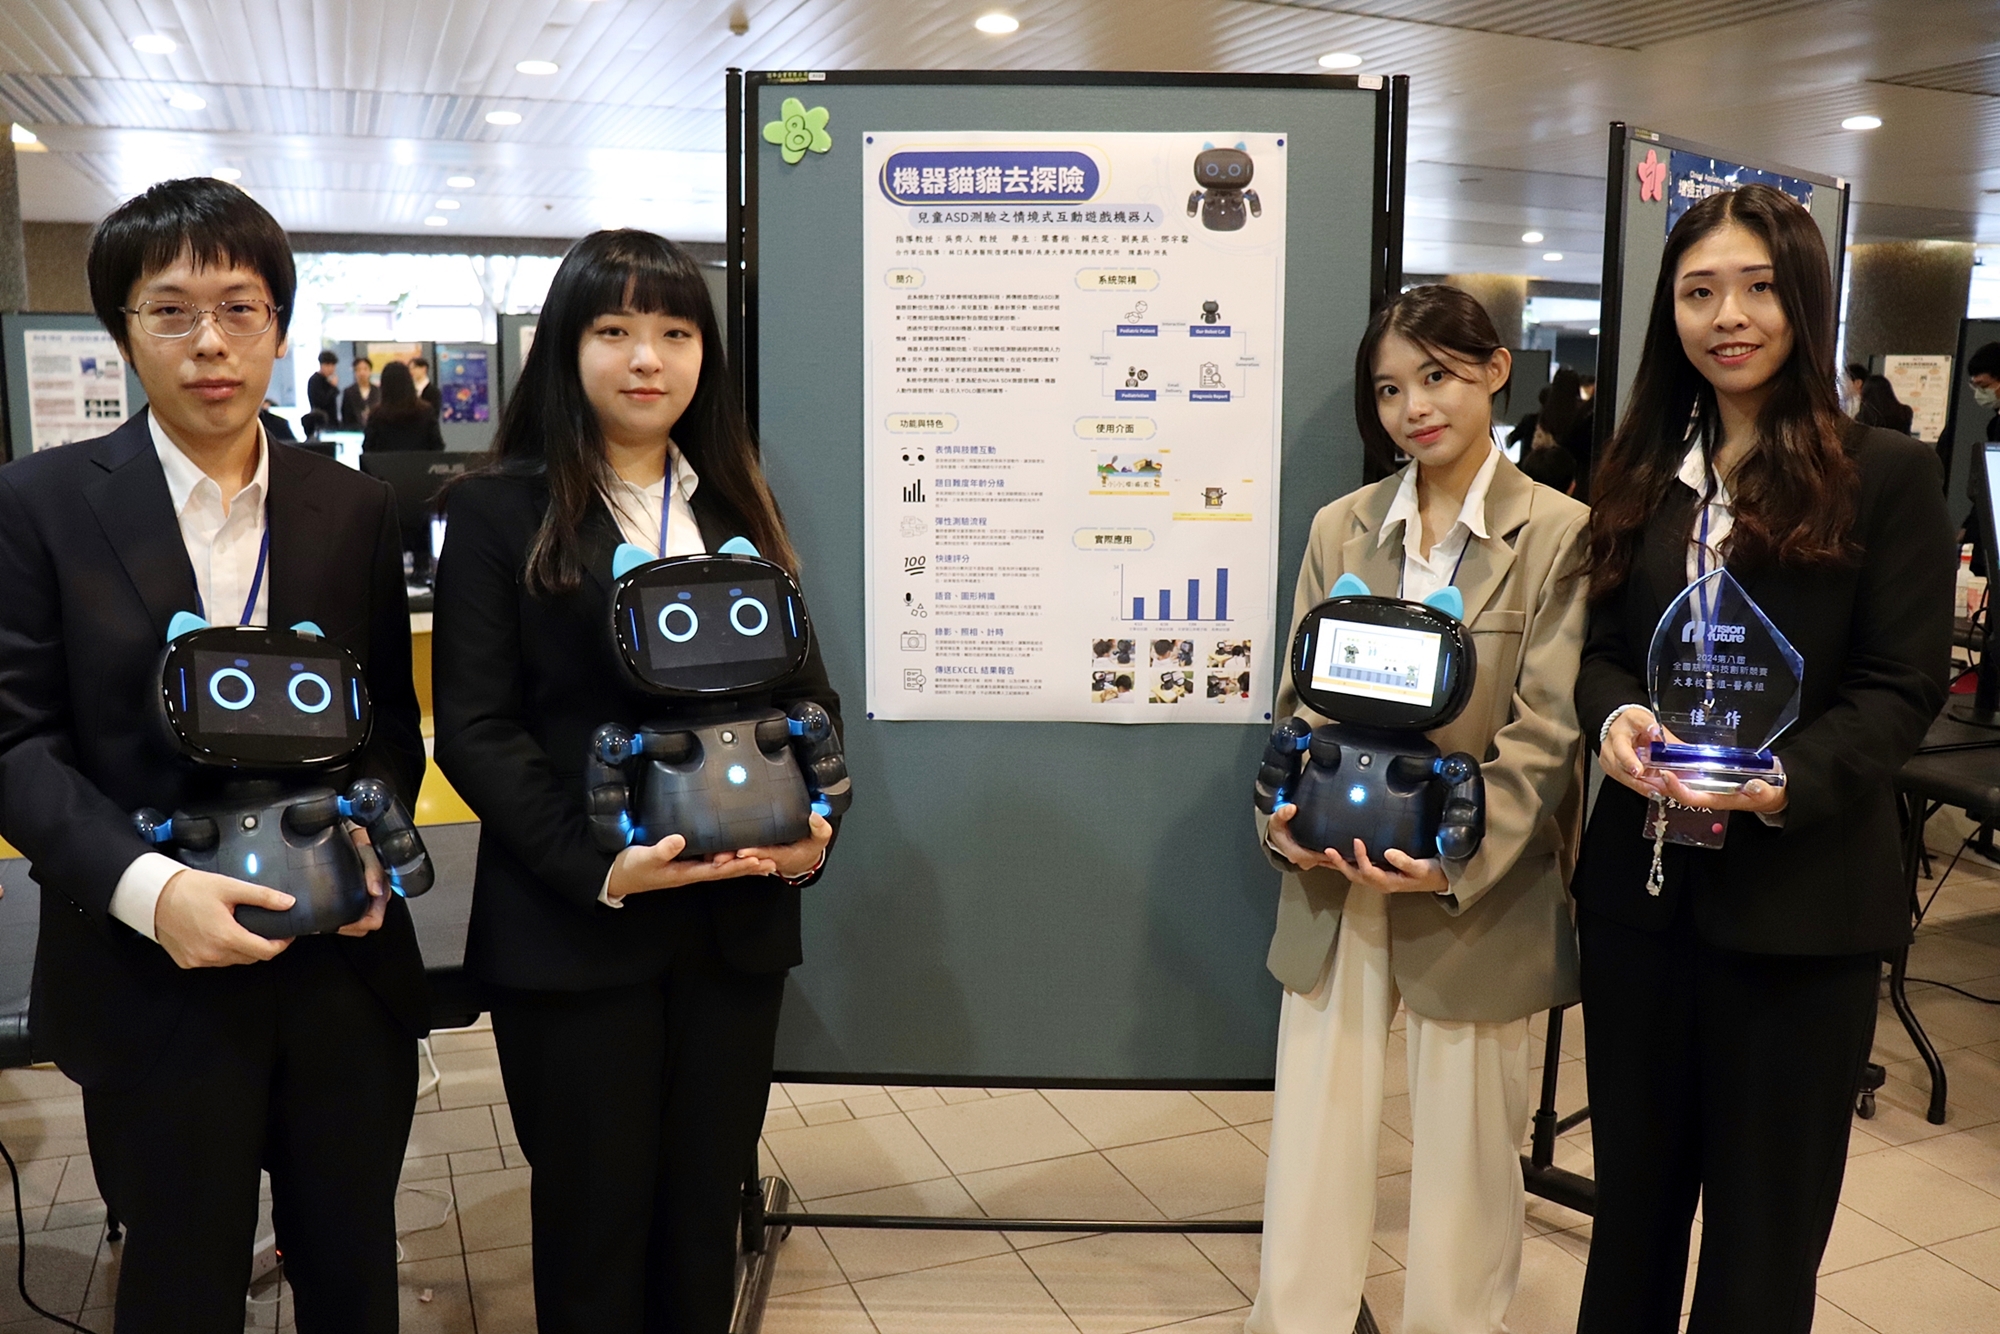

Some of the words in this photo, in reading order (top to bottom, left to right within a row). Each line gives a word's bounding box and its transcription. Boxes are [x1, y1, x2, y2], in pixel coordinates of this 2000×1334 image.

[892, 166, 1085, 195] 機器貓貓去探險
[918, 211, 1154, 223] 兒童ASD測驗之情境式互動遊戲機器人
[979, 235, 997, 243] 教授
[896, 275, 914, 284] 簡介
[1099, 275, 1137, 285] 系統架構
[900, 419, 943, 428] 功能與特色
[1096, 424, 1134, 433] 使用介面
[935, 445, 996, 454] 表情與肢體互動
[935, 479, 1005, 488] 題目難度年齡分級
[935, 517, 987, 526] 彈性測驗流程
[1095, 535, 1132, 544] 實際應用
[935, 554, 970, 563] 快速評分
[935, 592, 995, 600] 語音、圖形辨識
[935, 627, 1004, 636] 錄影、照相、計時
[1709, 625, 1745, 634] vision
[1708, 633, 1744, 643] future
[1697, 654, 1746, 665] 2024第八屆
[935, 666, 978, 674] 傳送EXCEL
[981, 666, 1014, 675] 結果報告
